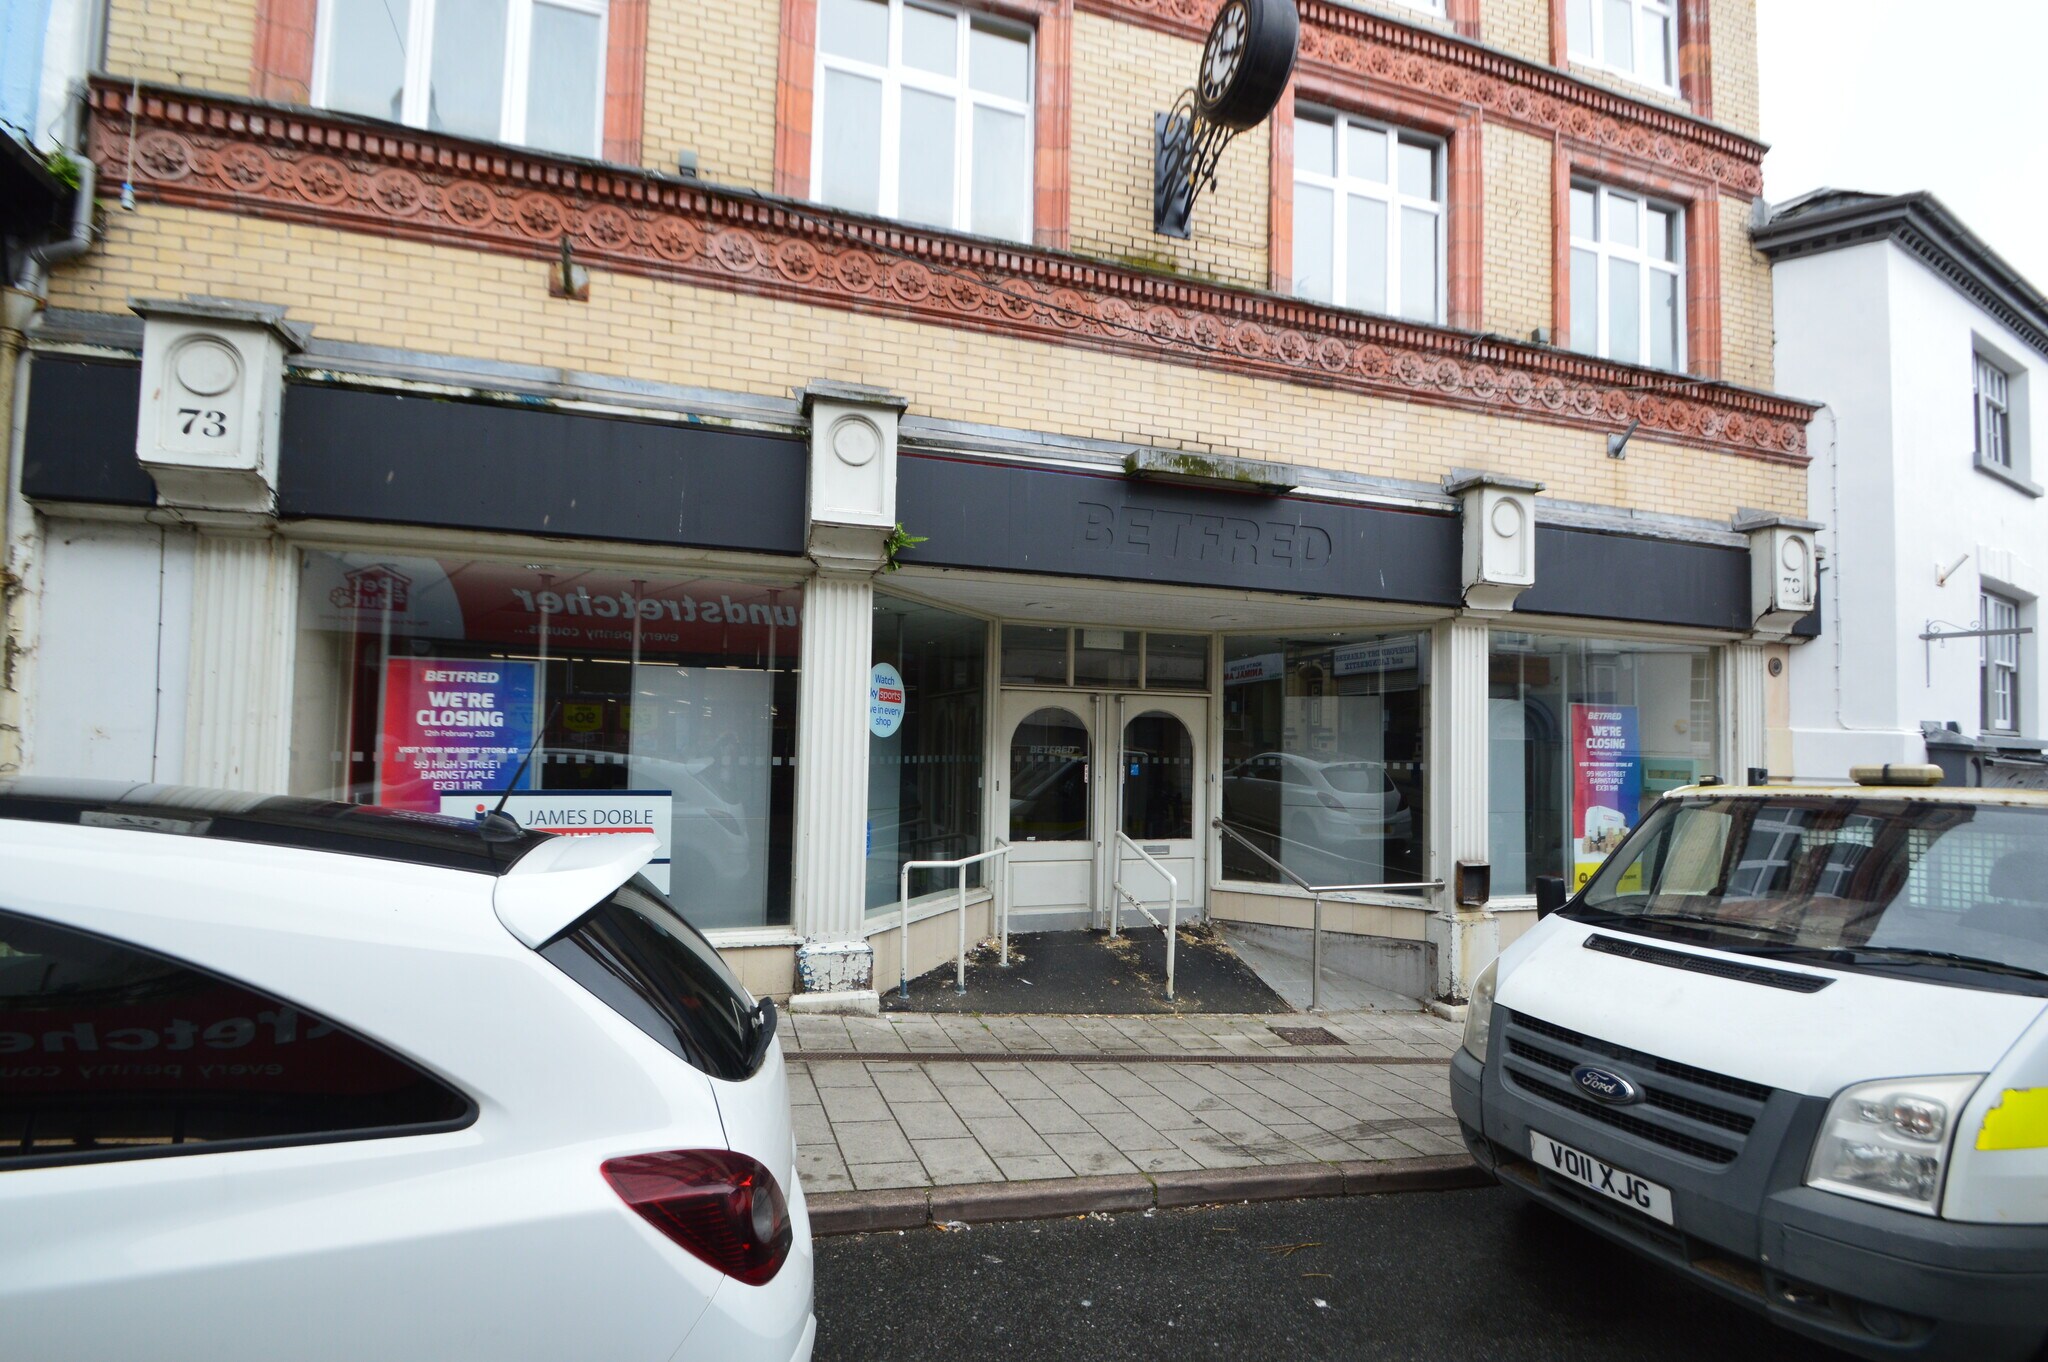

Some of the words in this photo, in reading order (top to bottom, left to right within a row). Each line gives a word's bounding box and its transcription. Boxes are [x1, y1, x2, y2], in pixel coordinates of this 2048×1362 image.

[178, 408, 226, 437] 73
[1074, 501, 1332, 571] BETFRED
[424, 670, 500, 683] BETFRED
[875, 674, 895, 685] Watch
[428, 691, 495, 708] WE'RE
[879, 690, 901, 701] sports
[878, 704, 883, 714] in
[884, 707, 901, 718] every
[1588, 712, 1622, 720] BETFRED
[416, 710, 504, 727] CLOSING
[875, 717, 891, 728] shop
[441, 730, 474, 738] February
[1591, 725, 1622, 737] WE'RE
[1586, 738, 1625, 749] CLOSING
[1030, 745, 1075, 754] BETFRED
[413, 759, 429, 769] 99
[432, 759, 458, 769] HIGH
[460, 759, 501, 769] STREET
[420, 770, 495, 780] BARNSTAPLE
[433, 781, 460, 790] EX31
[463, 781, 483, 790] 1HR
[526, 809, 587, 825] JAMES
[593, 809, 653, 825] DOBLE
[1582, 1071, 1617, 1094] Ford
[1598, 1164, 1651, 1209] XJG
